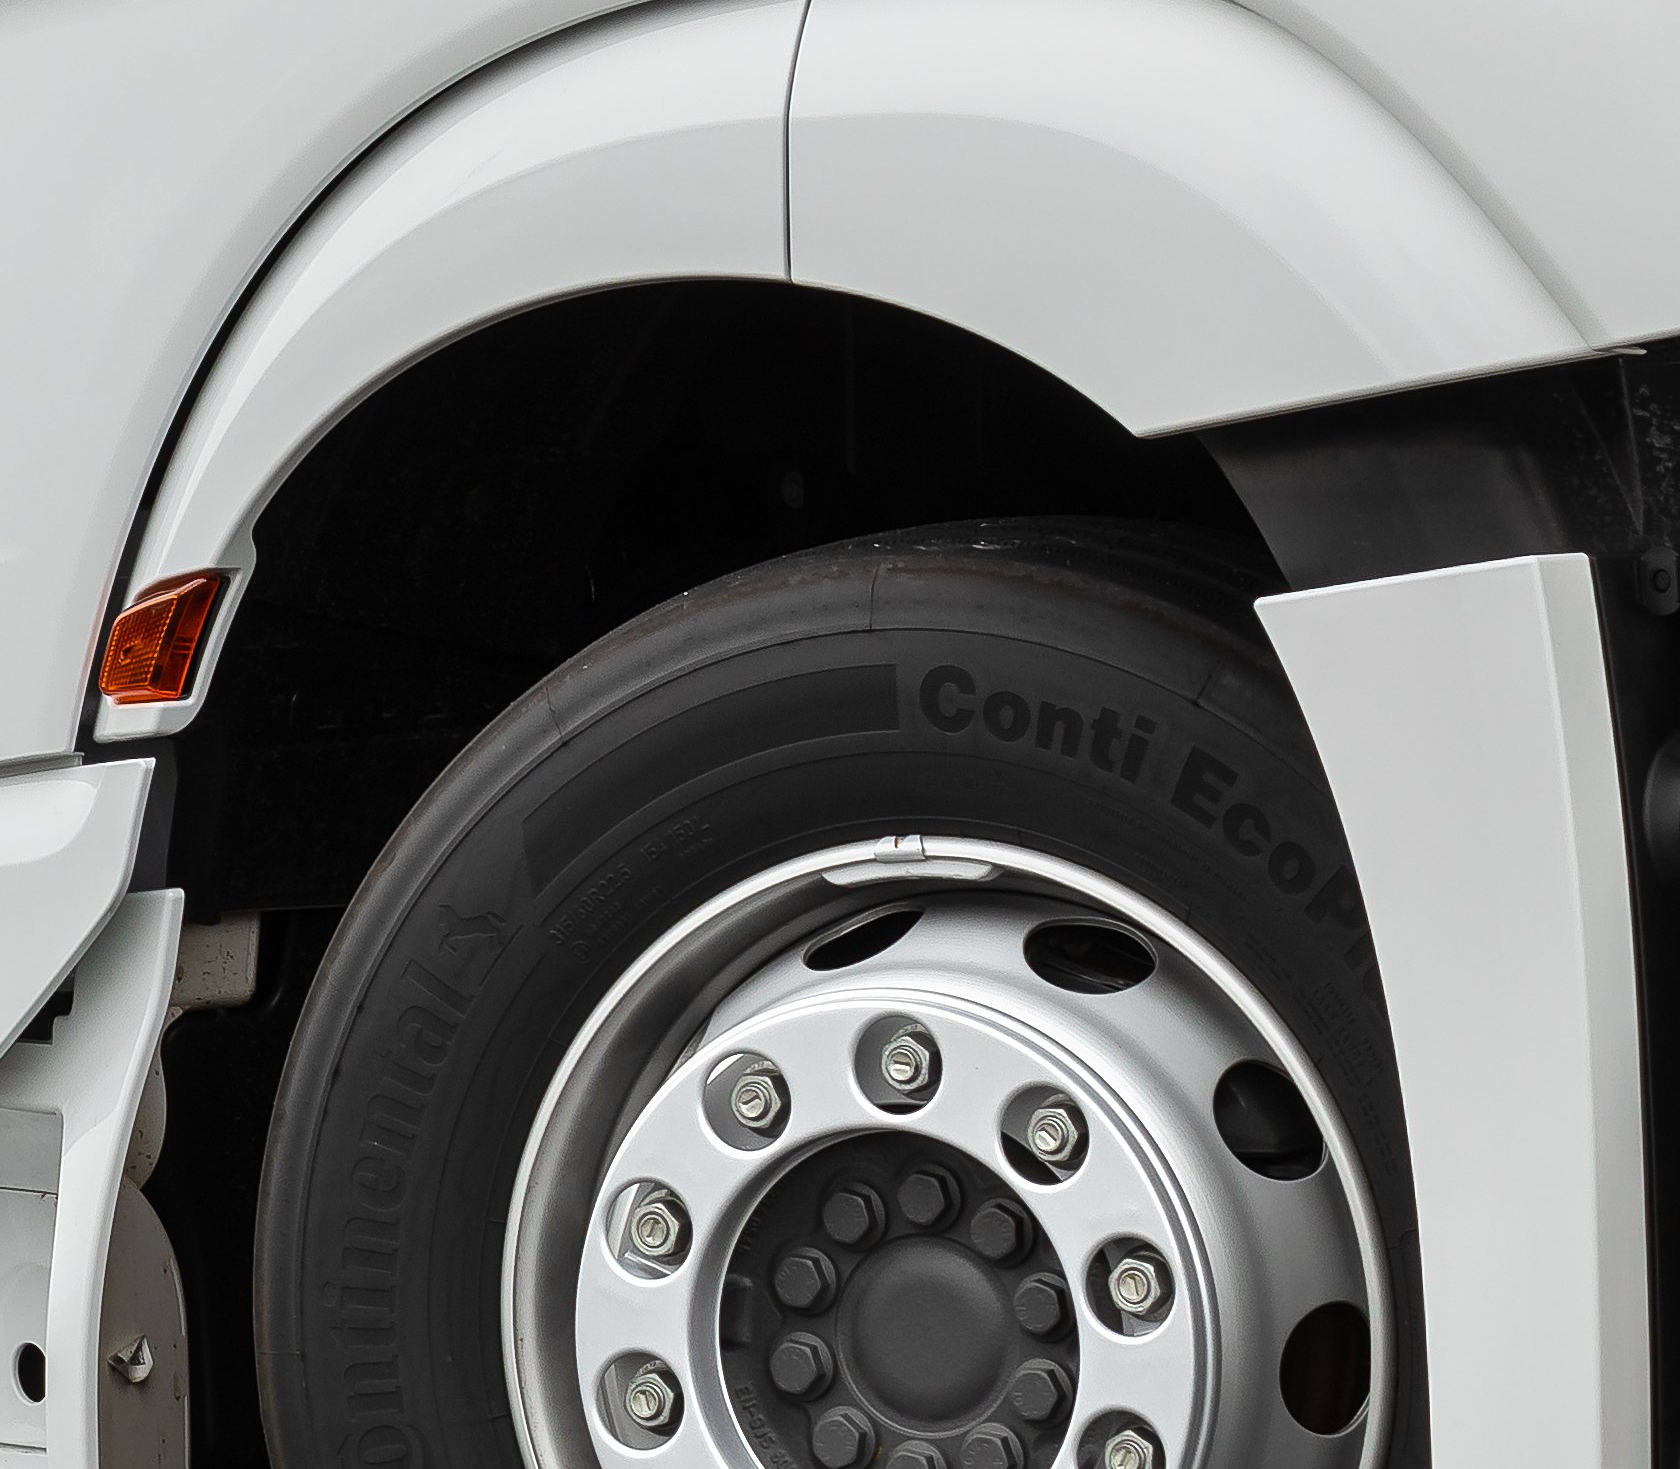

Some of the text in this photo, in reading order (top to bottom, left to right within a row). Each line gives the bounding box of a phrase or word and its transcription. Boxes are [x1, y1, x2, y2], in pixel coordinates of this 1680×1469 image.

[917, 662, 1158, 785] Conti
[1169, 744, 1378, 971] EcoP
[319, 955, 480, 1469] ontinental
